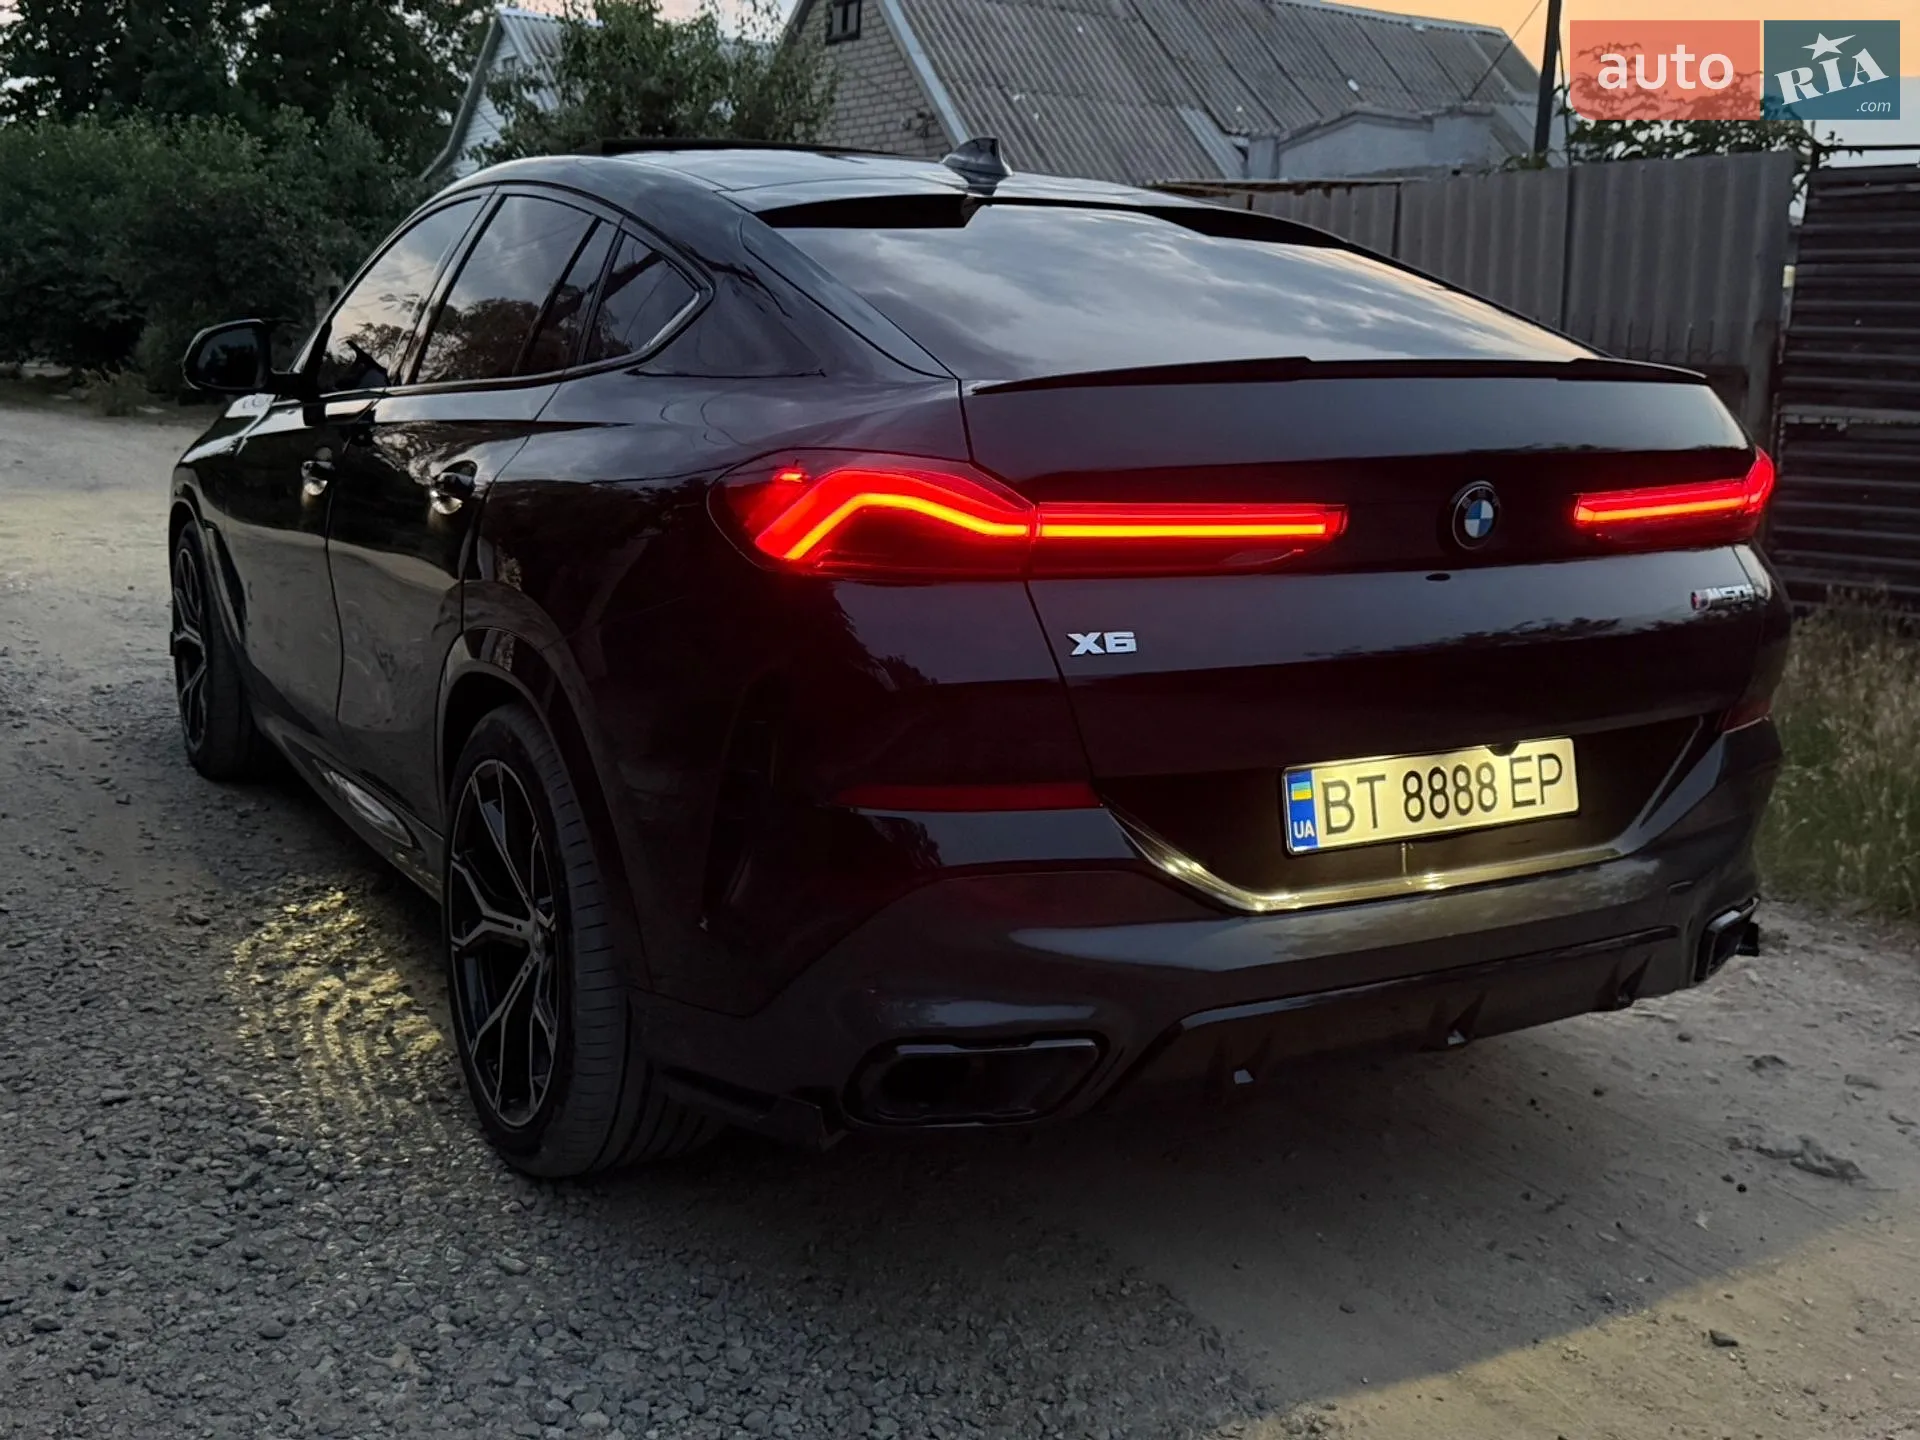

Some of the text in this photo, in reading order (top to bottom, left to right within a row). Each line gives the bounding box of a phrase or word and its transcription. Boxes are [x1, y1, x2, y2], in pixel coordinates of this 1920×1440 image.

[1066, 631, 1137, 656] X6
[1321, 752, 1563, 836] BT 8888 EP
[1293, 819, 1316, 840] UA
